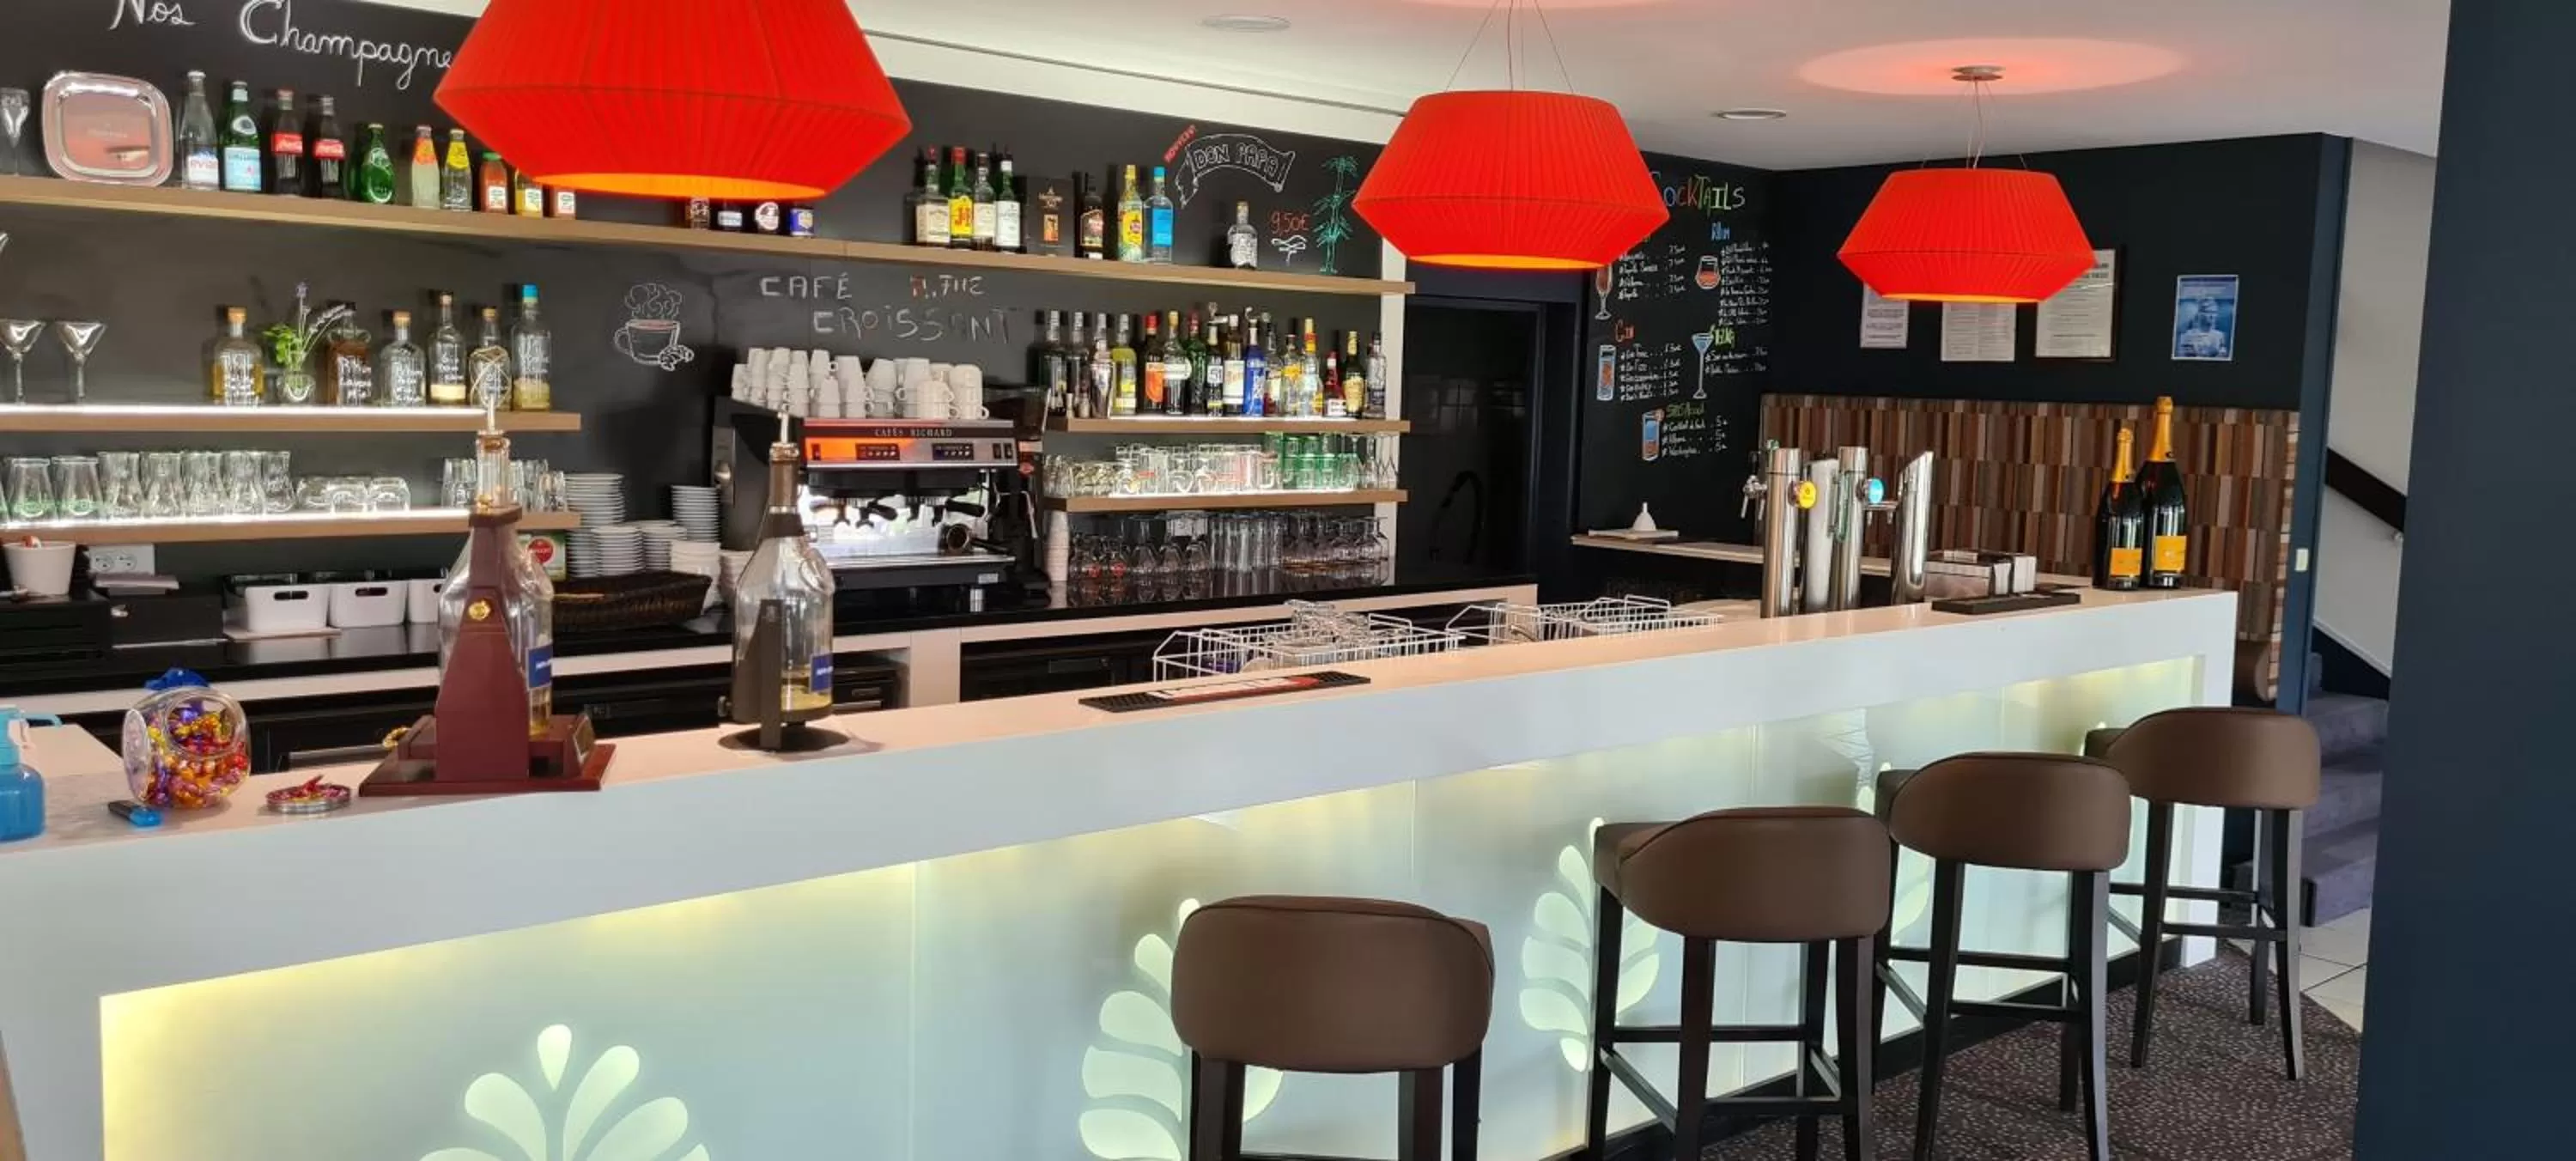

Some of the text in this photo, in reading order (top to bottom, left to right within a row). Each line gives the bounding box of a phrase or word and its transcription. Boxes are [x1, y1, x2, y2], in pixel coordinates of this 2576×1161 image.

[110, 0, 196, 30] Nos
[1193, 143, 1230, 169] DON
[1649, 171, 1746, 216] OCKTAILS
[759, 271, 853, 301] CAFÉ
[909, 428, 953, 438] RICHARD
